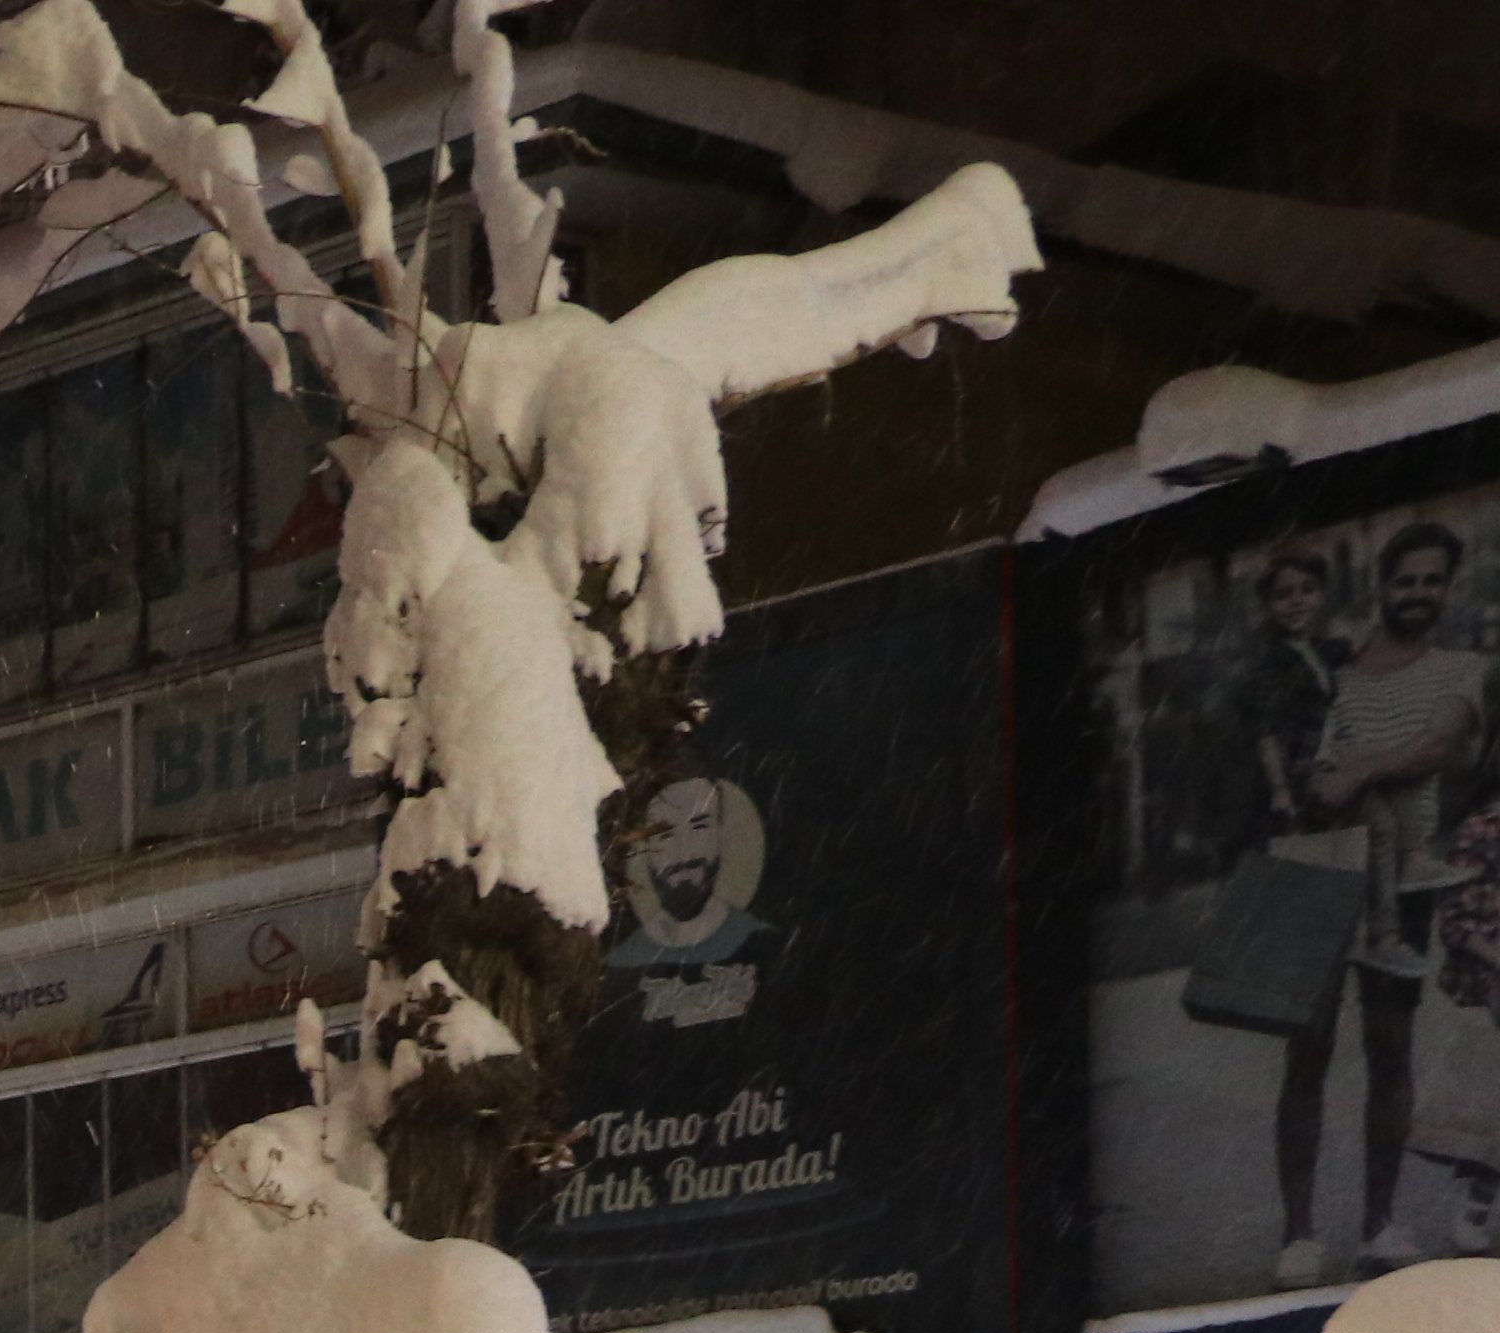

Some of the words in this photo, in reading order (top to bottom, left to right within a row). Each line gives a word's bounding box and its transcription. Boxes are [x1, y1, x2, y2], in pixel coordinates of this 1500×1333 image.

[588, 1108, 708, 1160] Tekno
[714, 1086, 788, 1148] Abi
[554, 1170, 654, 1226] Artık
[665, 1132, 843, 1206] Burada!
[826, 1272, 918, 1301] burada
